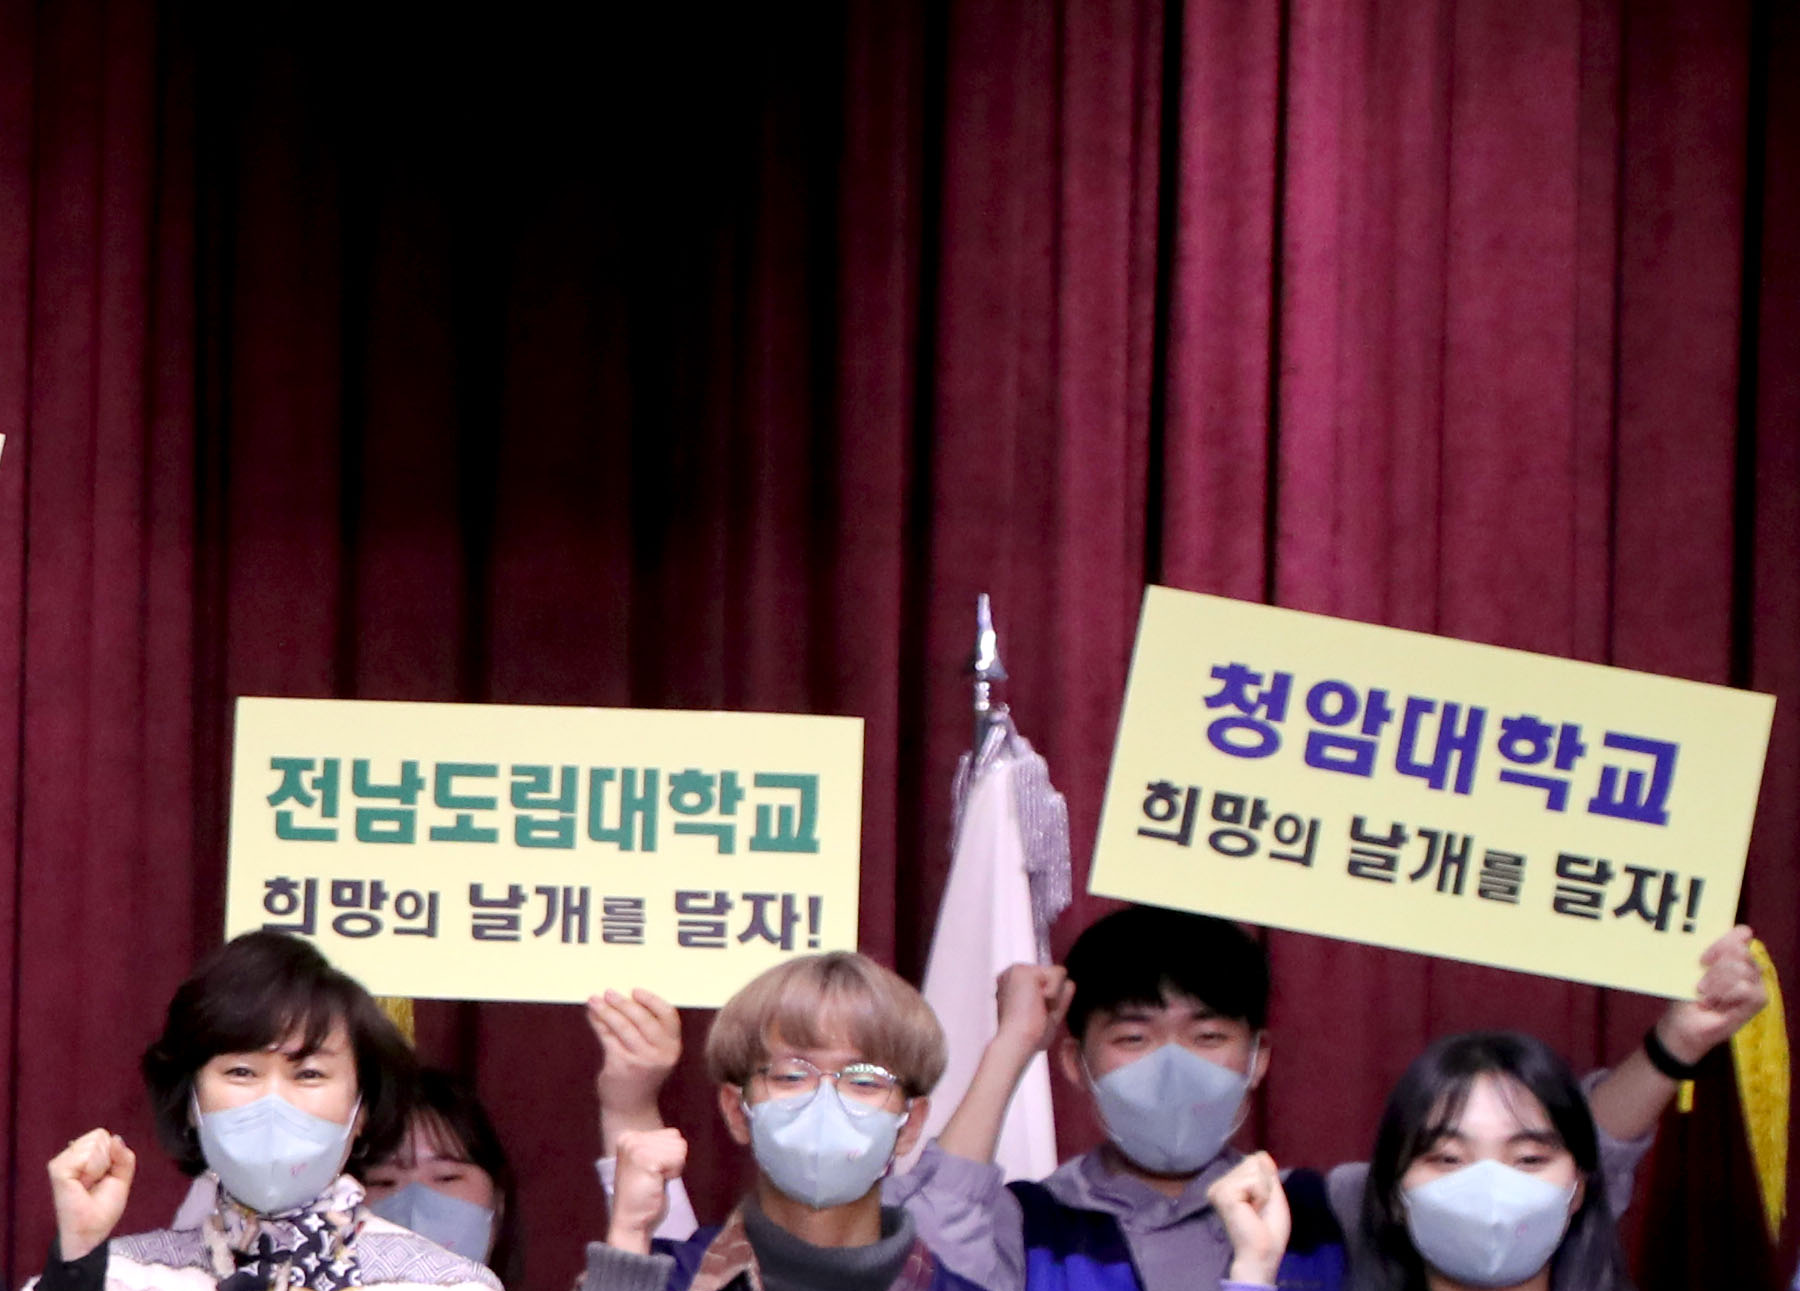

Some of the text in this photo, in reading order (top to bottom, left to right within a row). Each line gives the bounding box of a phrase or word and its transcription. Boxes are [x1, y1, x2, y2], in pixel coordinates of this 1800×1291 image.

[266, 755, 821, 855] 전남도립대학교
[1204, 662, 1680, 827] 청암대학교
[262, 876, 823, 951] 희망의 날개를 달자!
[1137, 779, 1706, 934] 희망의 날개를 달자!
